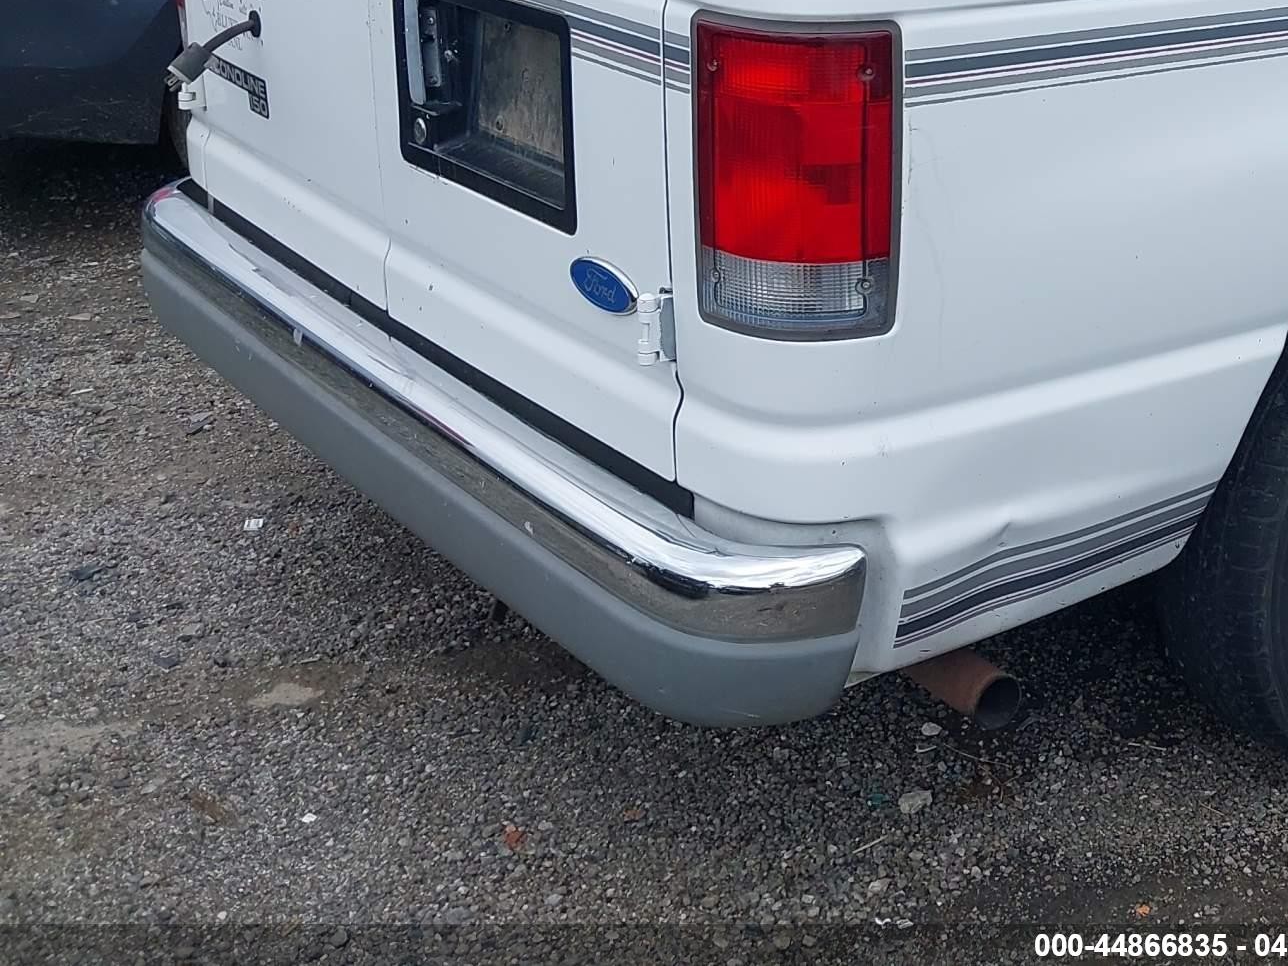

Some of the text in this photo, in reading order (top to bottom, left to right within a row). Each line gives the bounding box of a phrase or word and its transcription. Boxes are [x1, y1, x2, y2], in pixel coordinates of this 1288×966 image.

[207, 55, 266, 99] CONOLINE
[250, 94, 268, 117] 150
[583, 267, 618, 304] Ford
